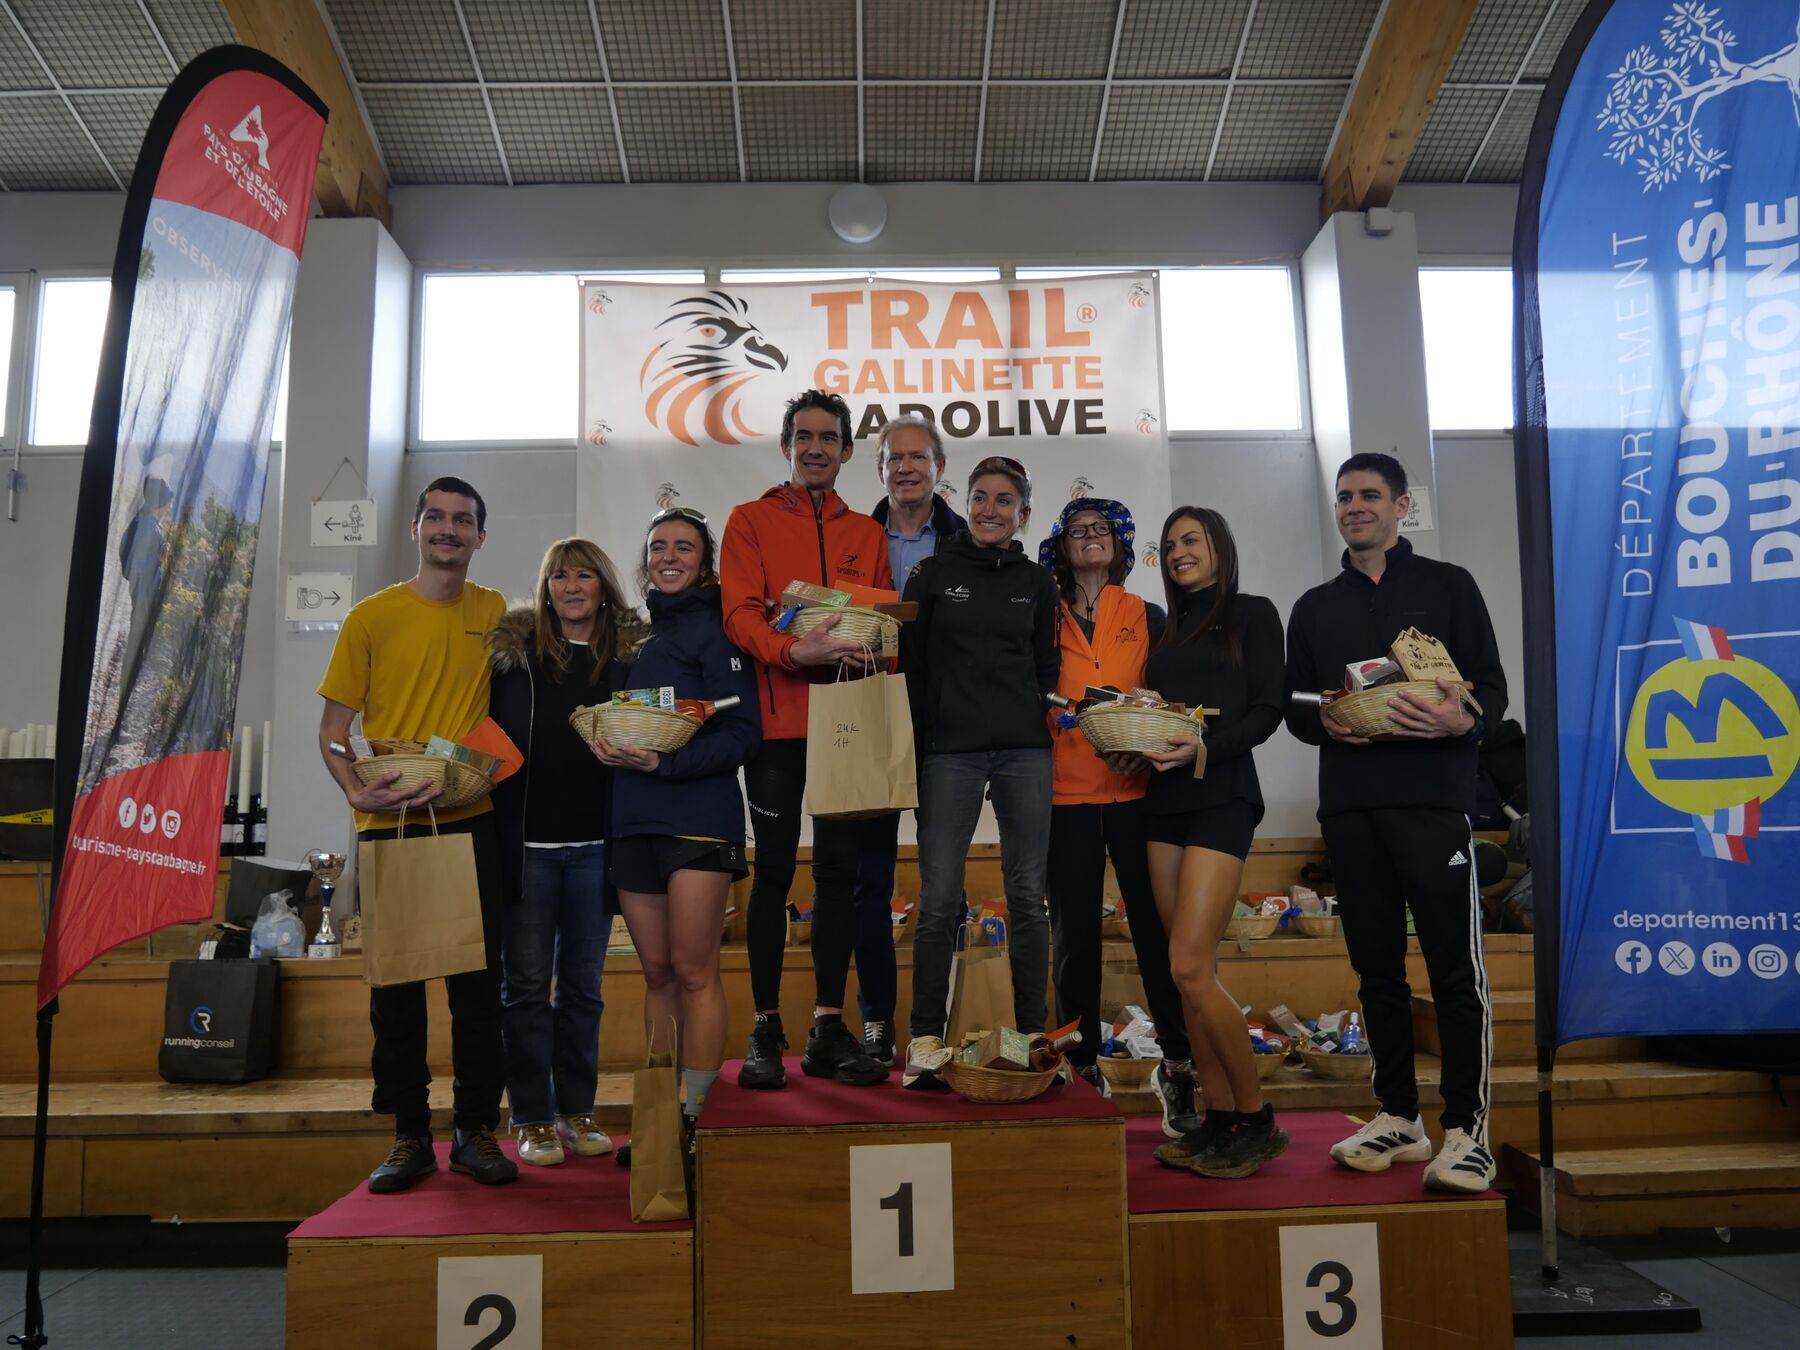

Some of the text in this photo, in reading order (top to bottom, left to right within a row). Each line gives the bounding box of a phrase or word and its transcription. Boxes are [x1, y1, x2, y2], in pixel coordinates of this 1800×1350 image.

[203, 123, 229, 157] PAYS
[231, 151, 288, 216] D'AUBAGNE
[204, 146, 221, 164] ET
[224, 159, 240, 180] DE
[813, 356, 1104, 394] GALINETTE
[1612, 231, 1653, 597] DÉPARTEMENT
[343, 534, 363, 542] Kiné
[1401, 519, 1420, 528] Kiné
[1448, 858, 1468, 866] adidas
[880, 1182, 915, 1257] 1
[463, 1294, 517, 1350] 2
[1305, 1261, 1358, 1338] 3
